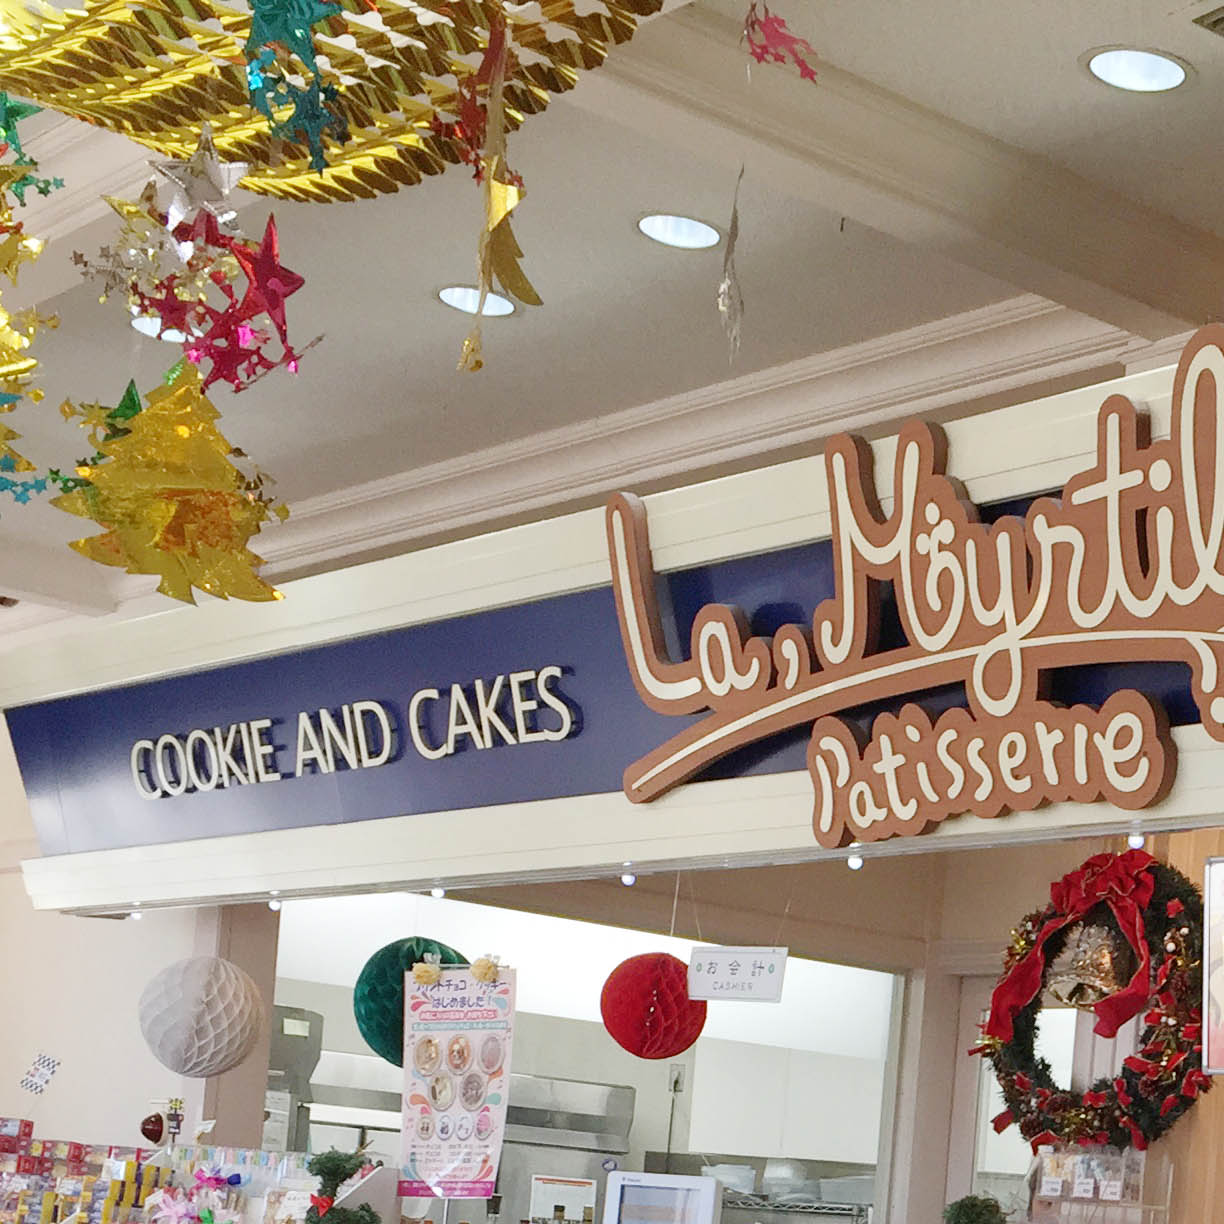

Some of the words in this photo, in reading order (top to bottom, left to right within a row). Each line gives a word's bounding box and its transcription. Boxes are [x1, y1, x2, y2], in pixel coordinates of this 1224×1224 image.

[129, 717, 281, 801] COOKIE
[294, 699, 393, 778] AND
[408, 664, 575, 761] CAKES
[815, 710, 1151, 834] Patisserie
[706, 959, 766, 977] お会計
